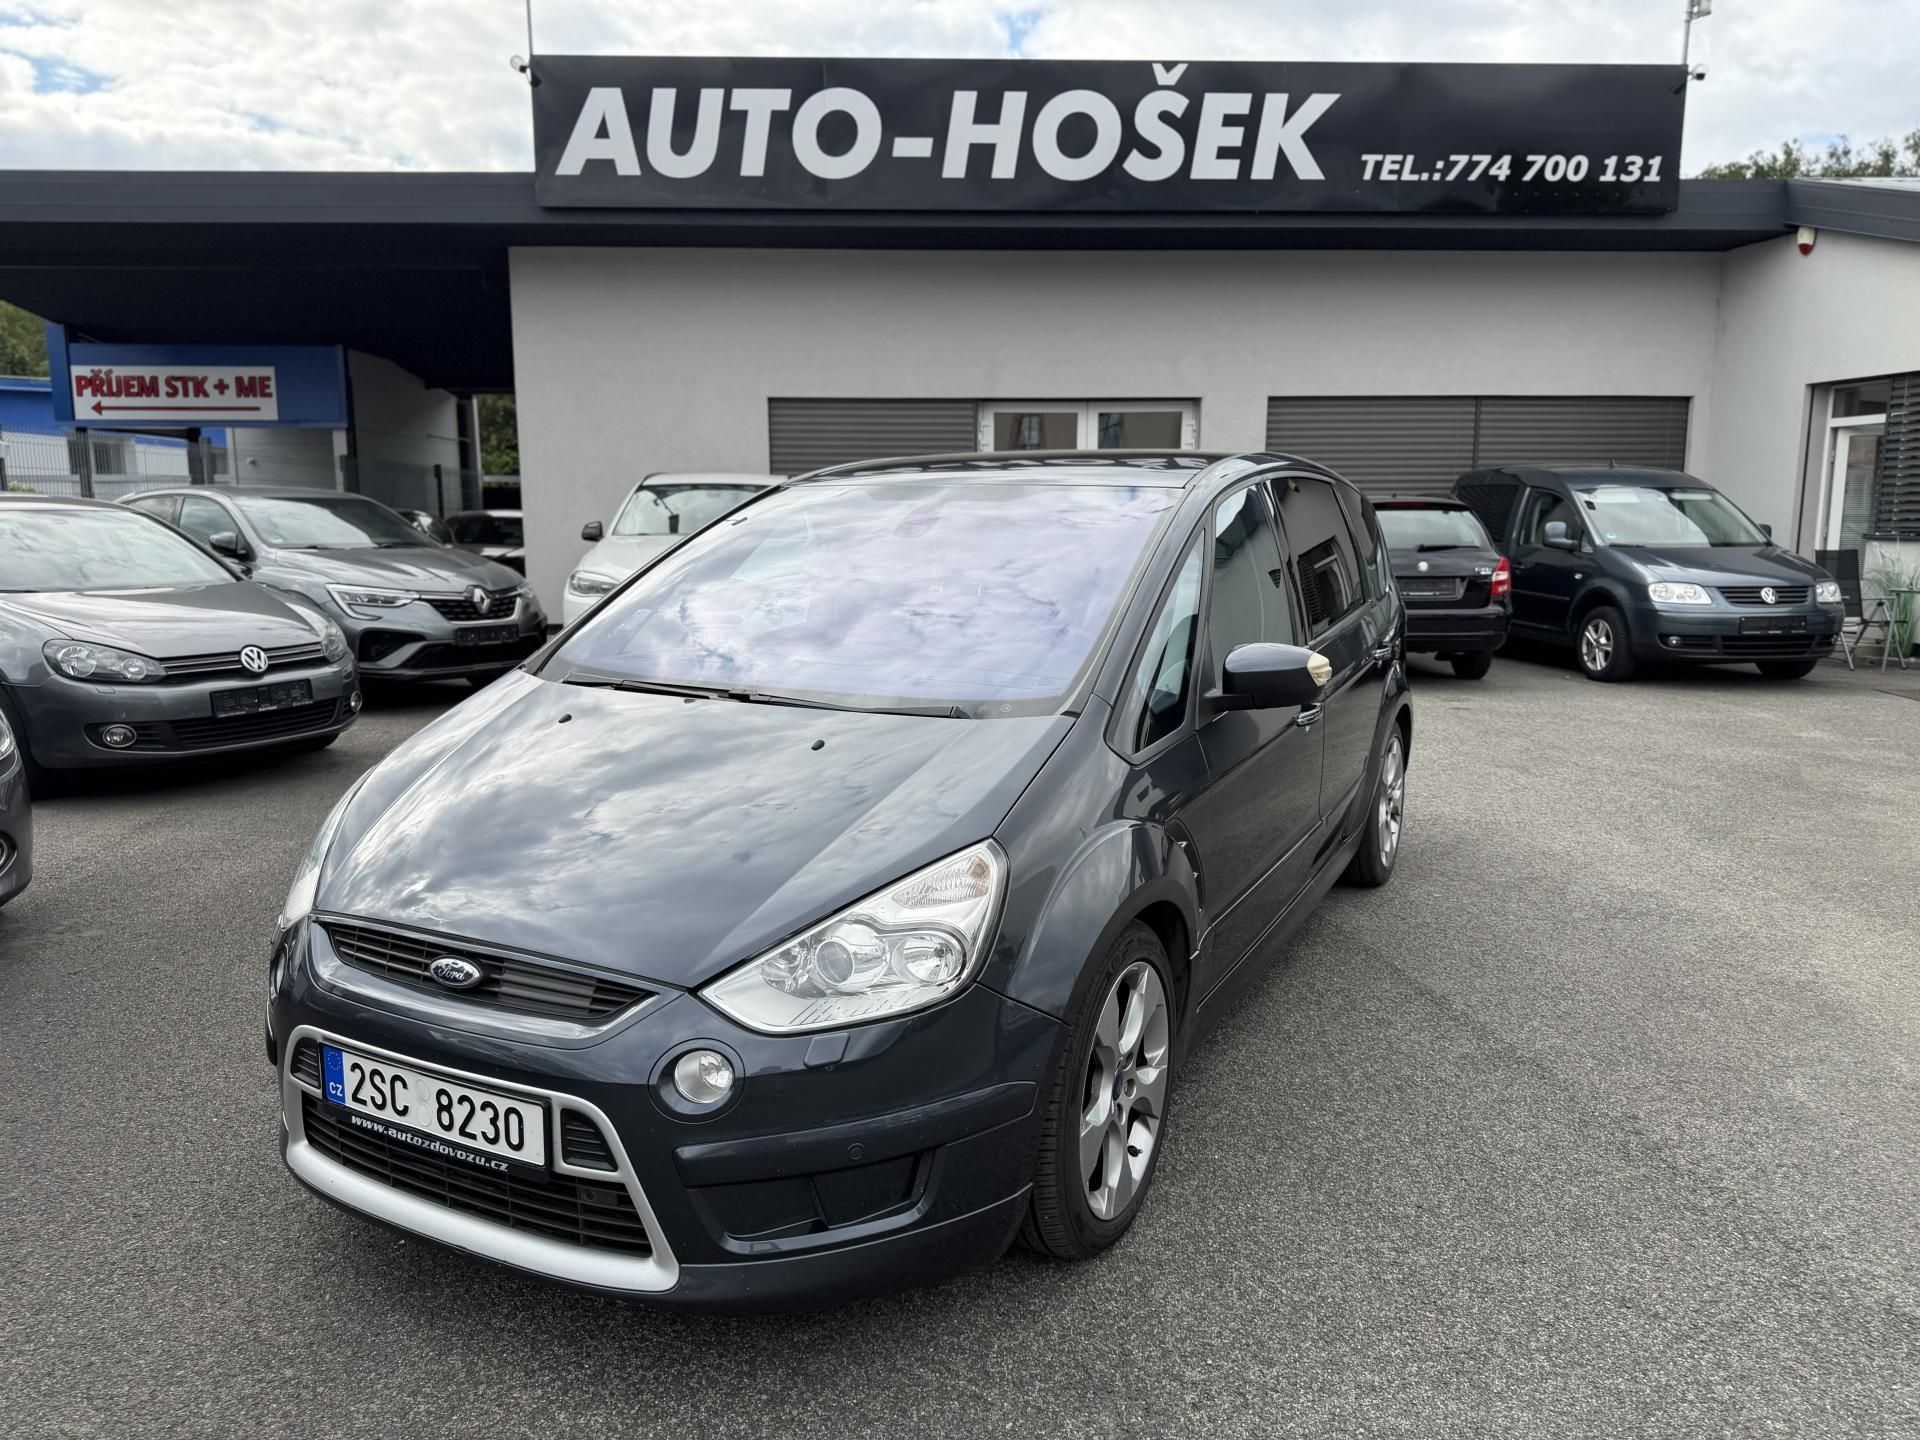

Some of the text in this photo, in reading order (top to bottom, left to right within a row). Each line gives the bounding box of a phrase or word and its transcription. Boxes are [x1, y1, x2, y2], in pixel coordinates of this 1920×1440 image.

[555, 63, 1342, 182] AUTO-HOŠEK
[1361, 154, 1662, 182] TEL.:774 700 131
[75, 368, 160, 398] PŘÍJEM
[165, 375, 210, 398] STK
[235, 375, 273, 398] ME
[438, 961, 465, 981] Ford
[329, 1081, 343, 1097] CZ
[350, 1062, 524, 1151] 2SC 8230
[351, 1115, 509, 1172] www.autozdovozu.cz
